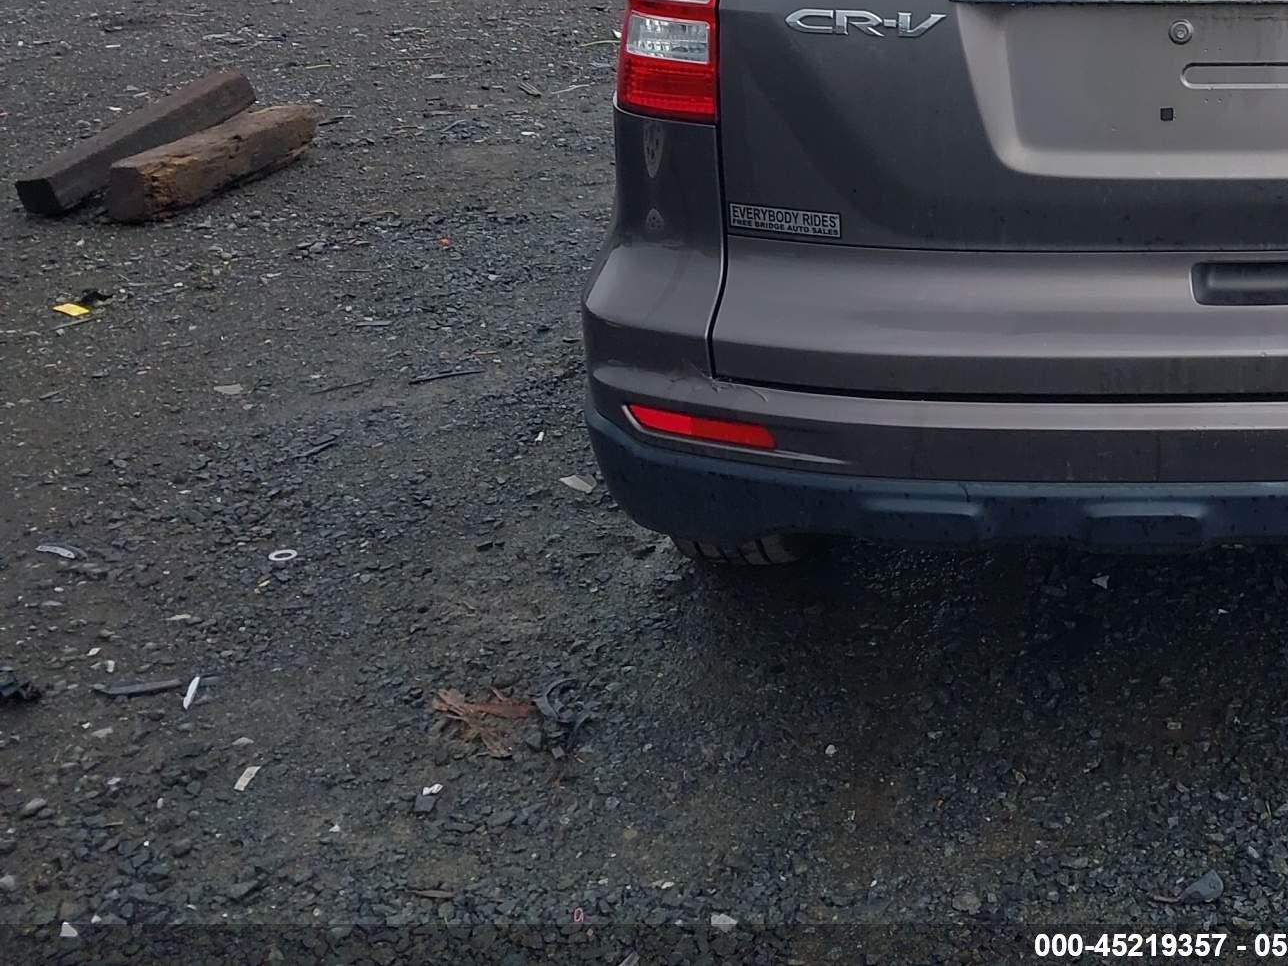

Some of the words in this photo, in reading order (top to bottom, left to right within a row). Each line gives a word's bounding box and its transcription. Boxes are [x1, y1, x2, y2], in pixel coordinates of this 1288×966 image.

[785, 8, 947, 37] CR-V
[732, 205, 799, 225] EVERYBODY
[802, 213, 837, 228] RIDES
[732, 218, 753, 227] FREE
[755, 221, 785, 231] BRIDGE
[787, 225, 810, 233] AUTO
[812, 227, 838, 236] SALES
